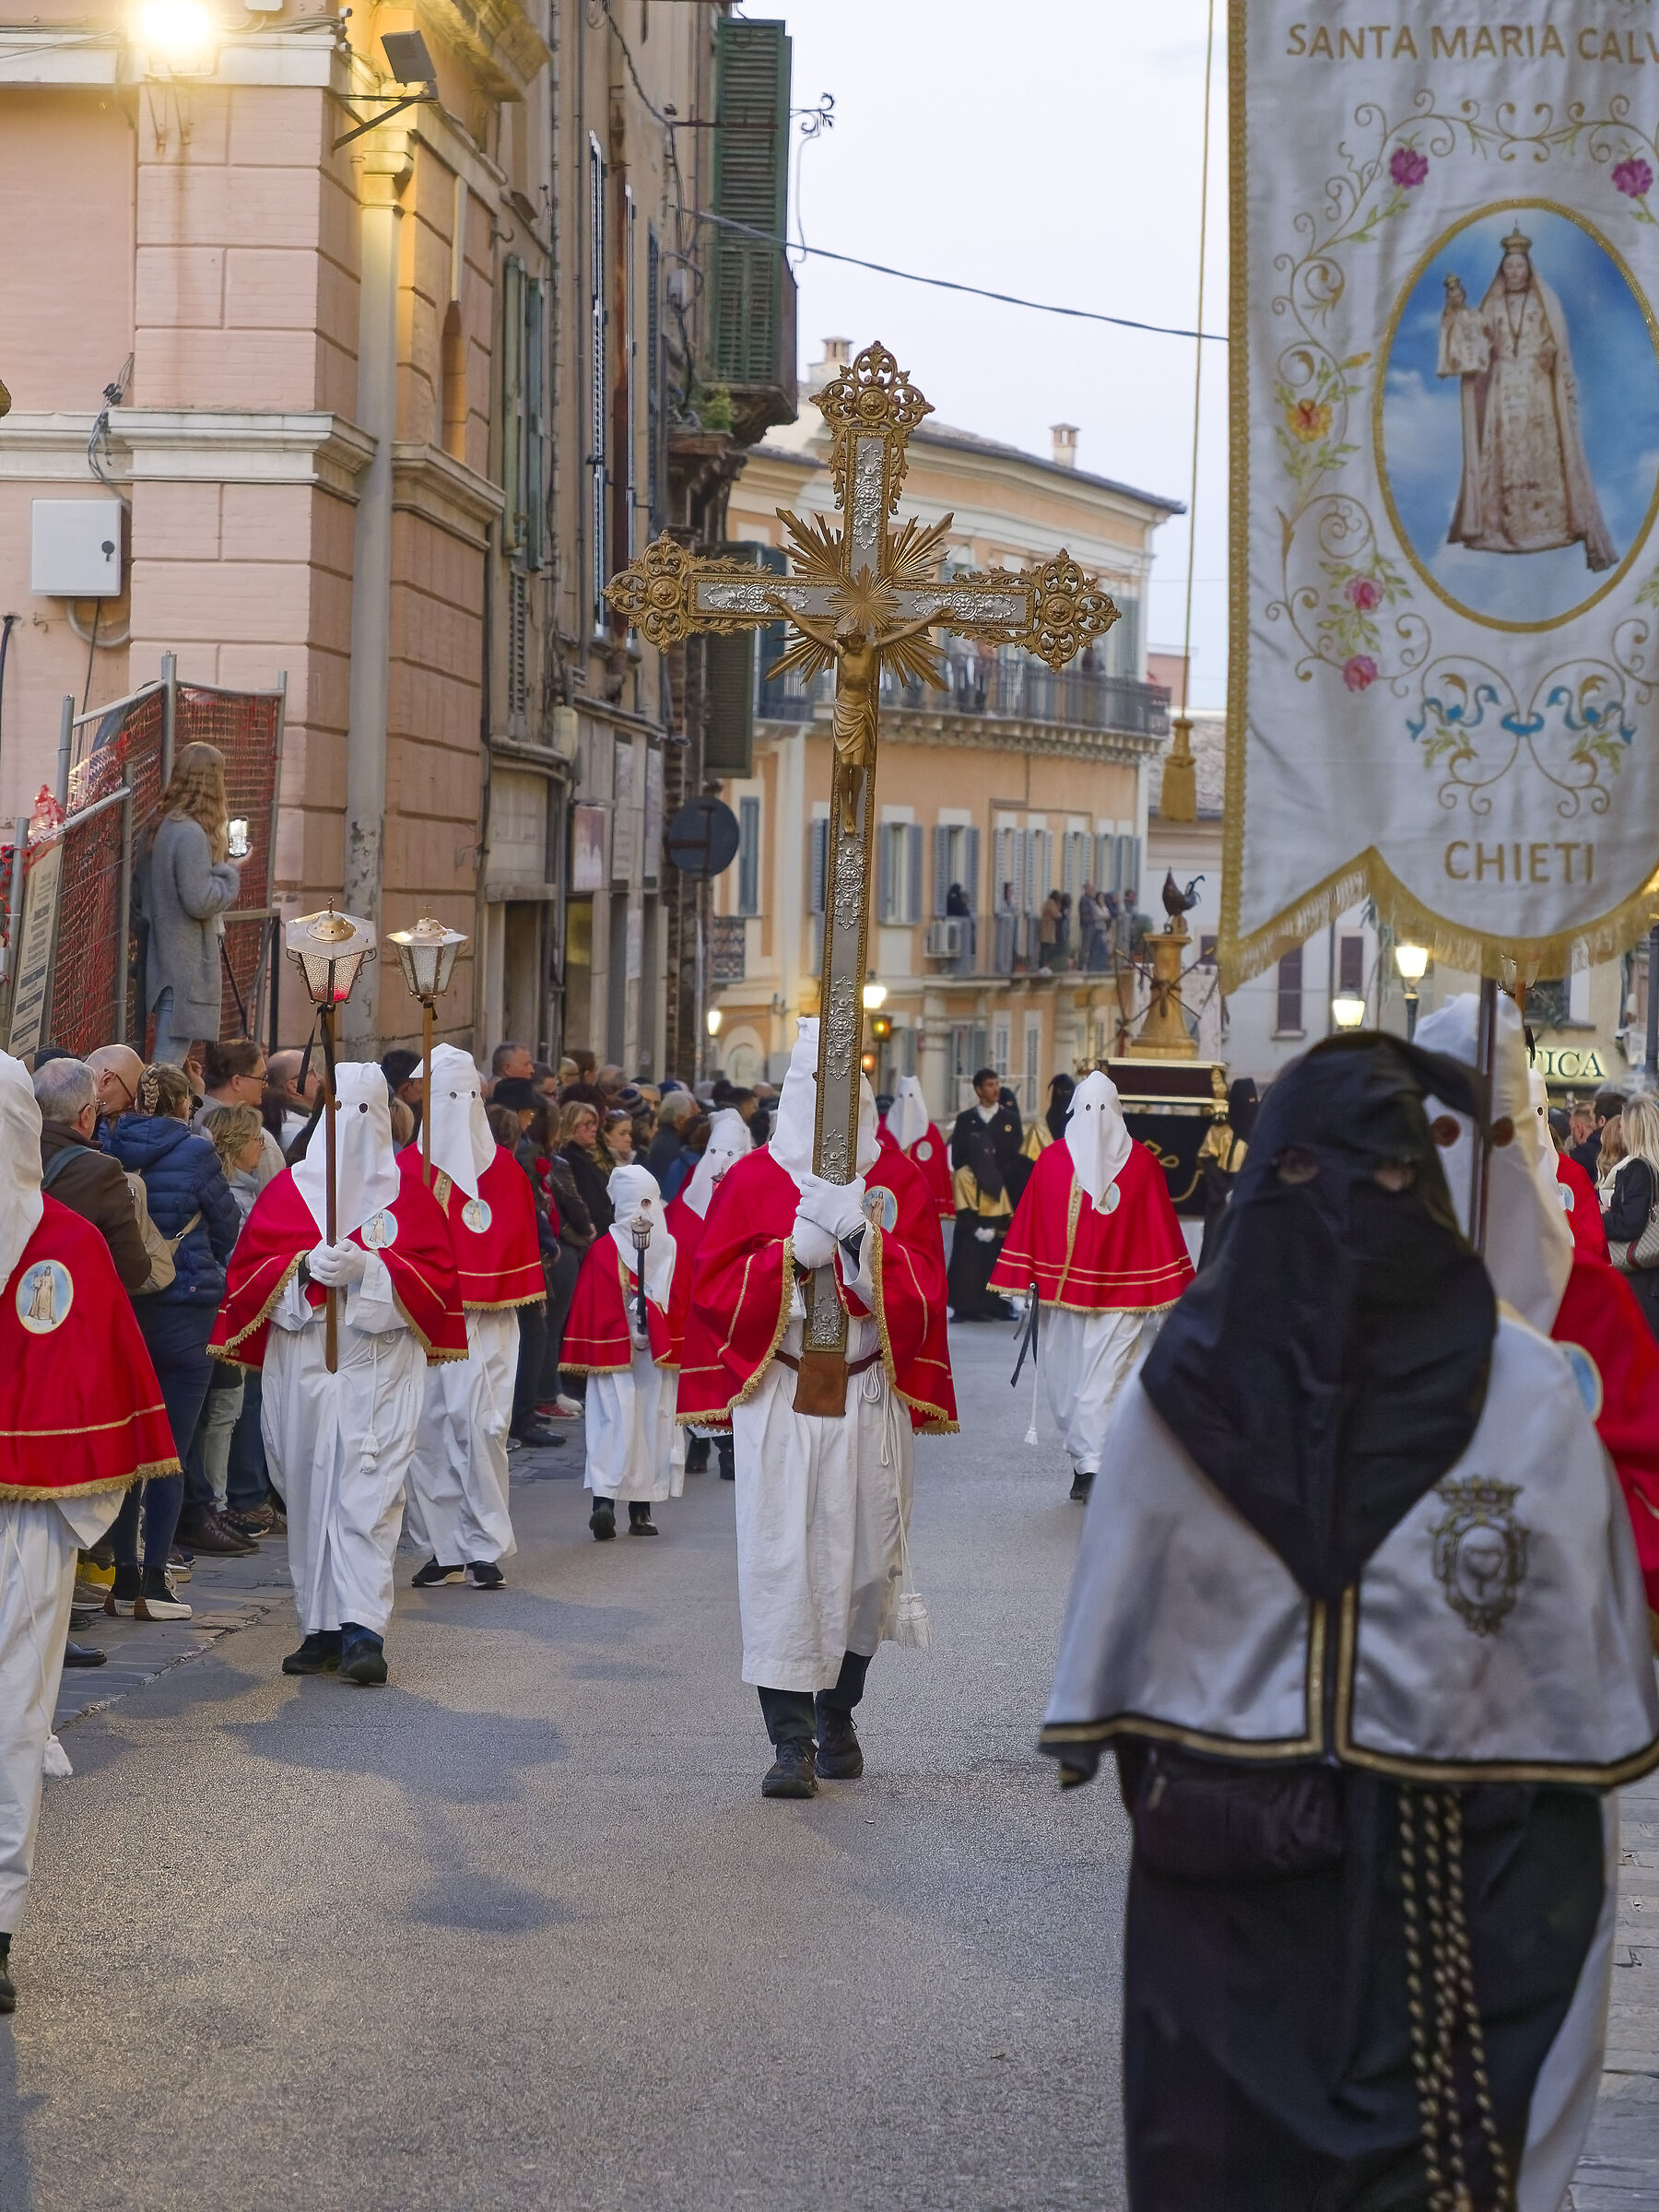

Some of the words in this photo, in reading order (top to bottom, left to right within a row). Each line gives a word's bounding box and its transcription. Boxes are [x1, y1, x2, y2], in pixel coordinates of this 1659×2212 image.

[1286, 23, 1418, 60] SANTA
[1430, 24, 1565, 59] MARIA
[1444, 841, 1594, 884] CHIETI
